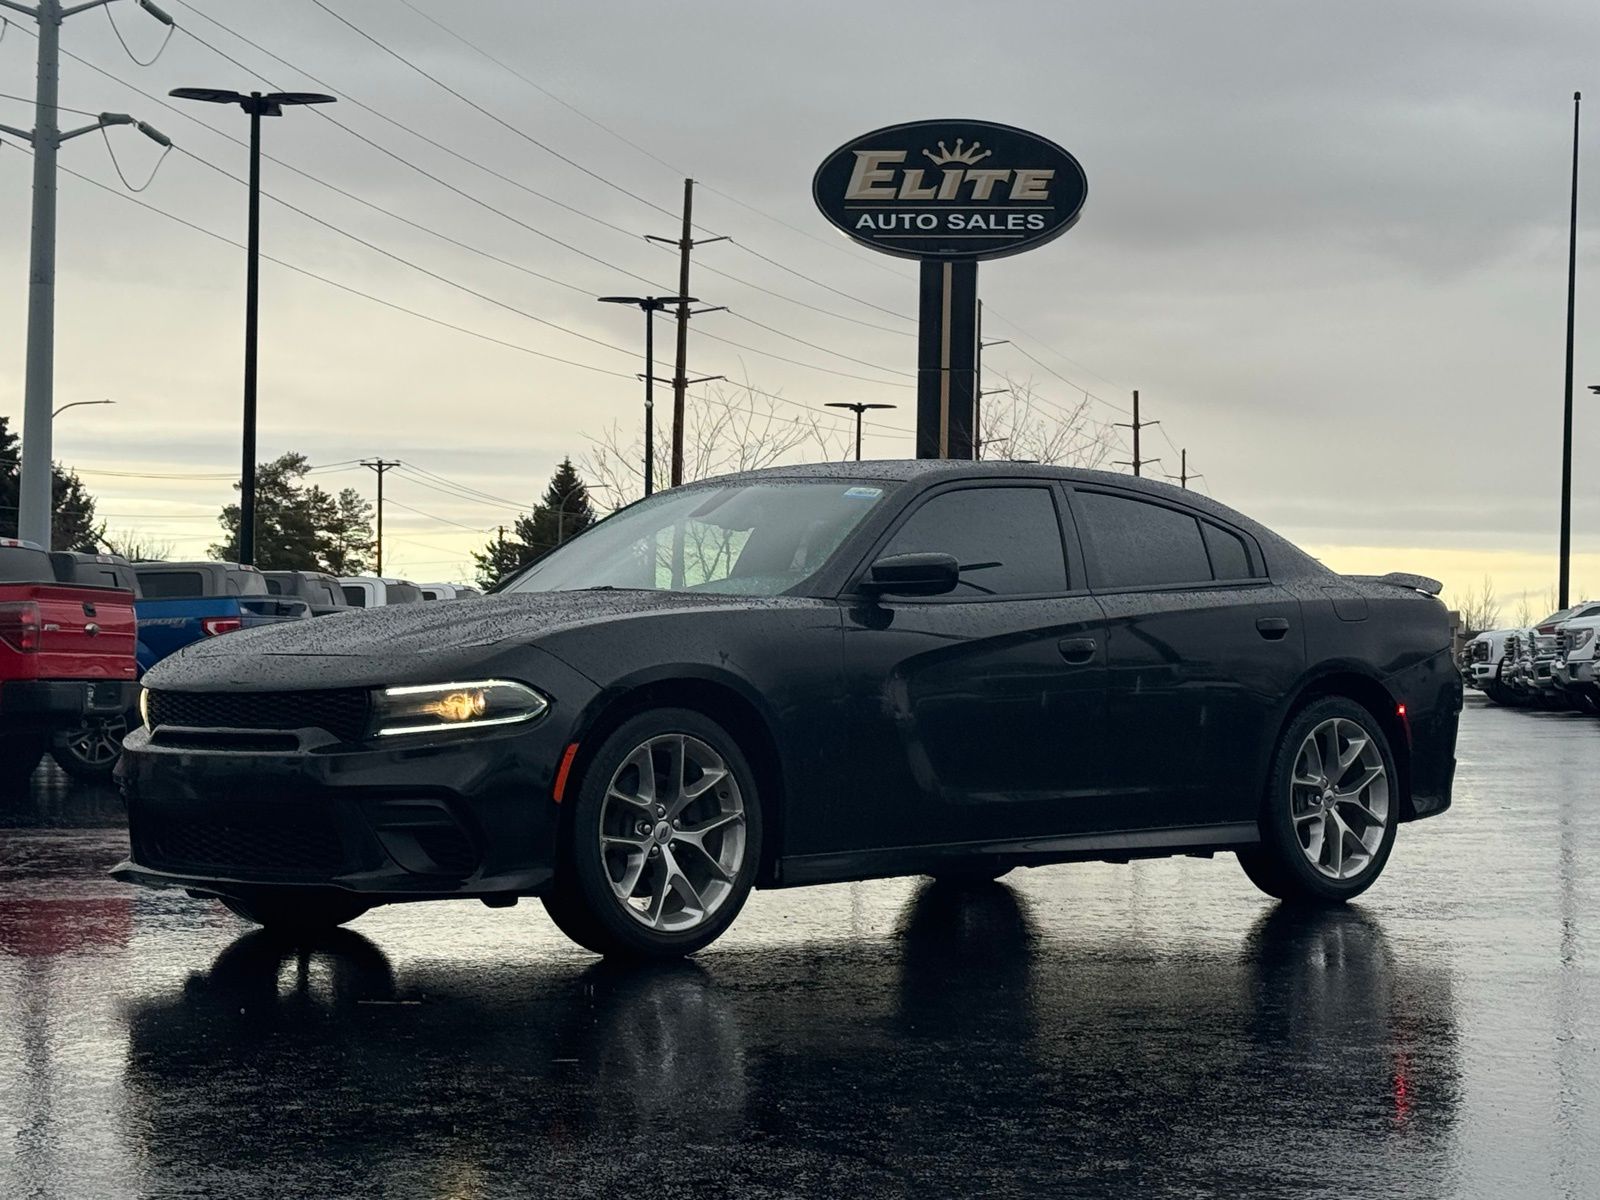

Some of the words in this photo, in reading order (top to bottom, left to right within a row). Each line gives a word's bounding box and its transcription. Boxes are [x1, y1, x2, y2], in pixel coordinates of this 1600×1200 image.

[844, 150, 1055, 200] ELITE
[855, 213, 937, 230] AUTO
[947, 213, 1045, 230] SALES
